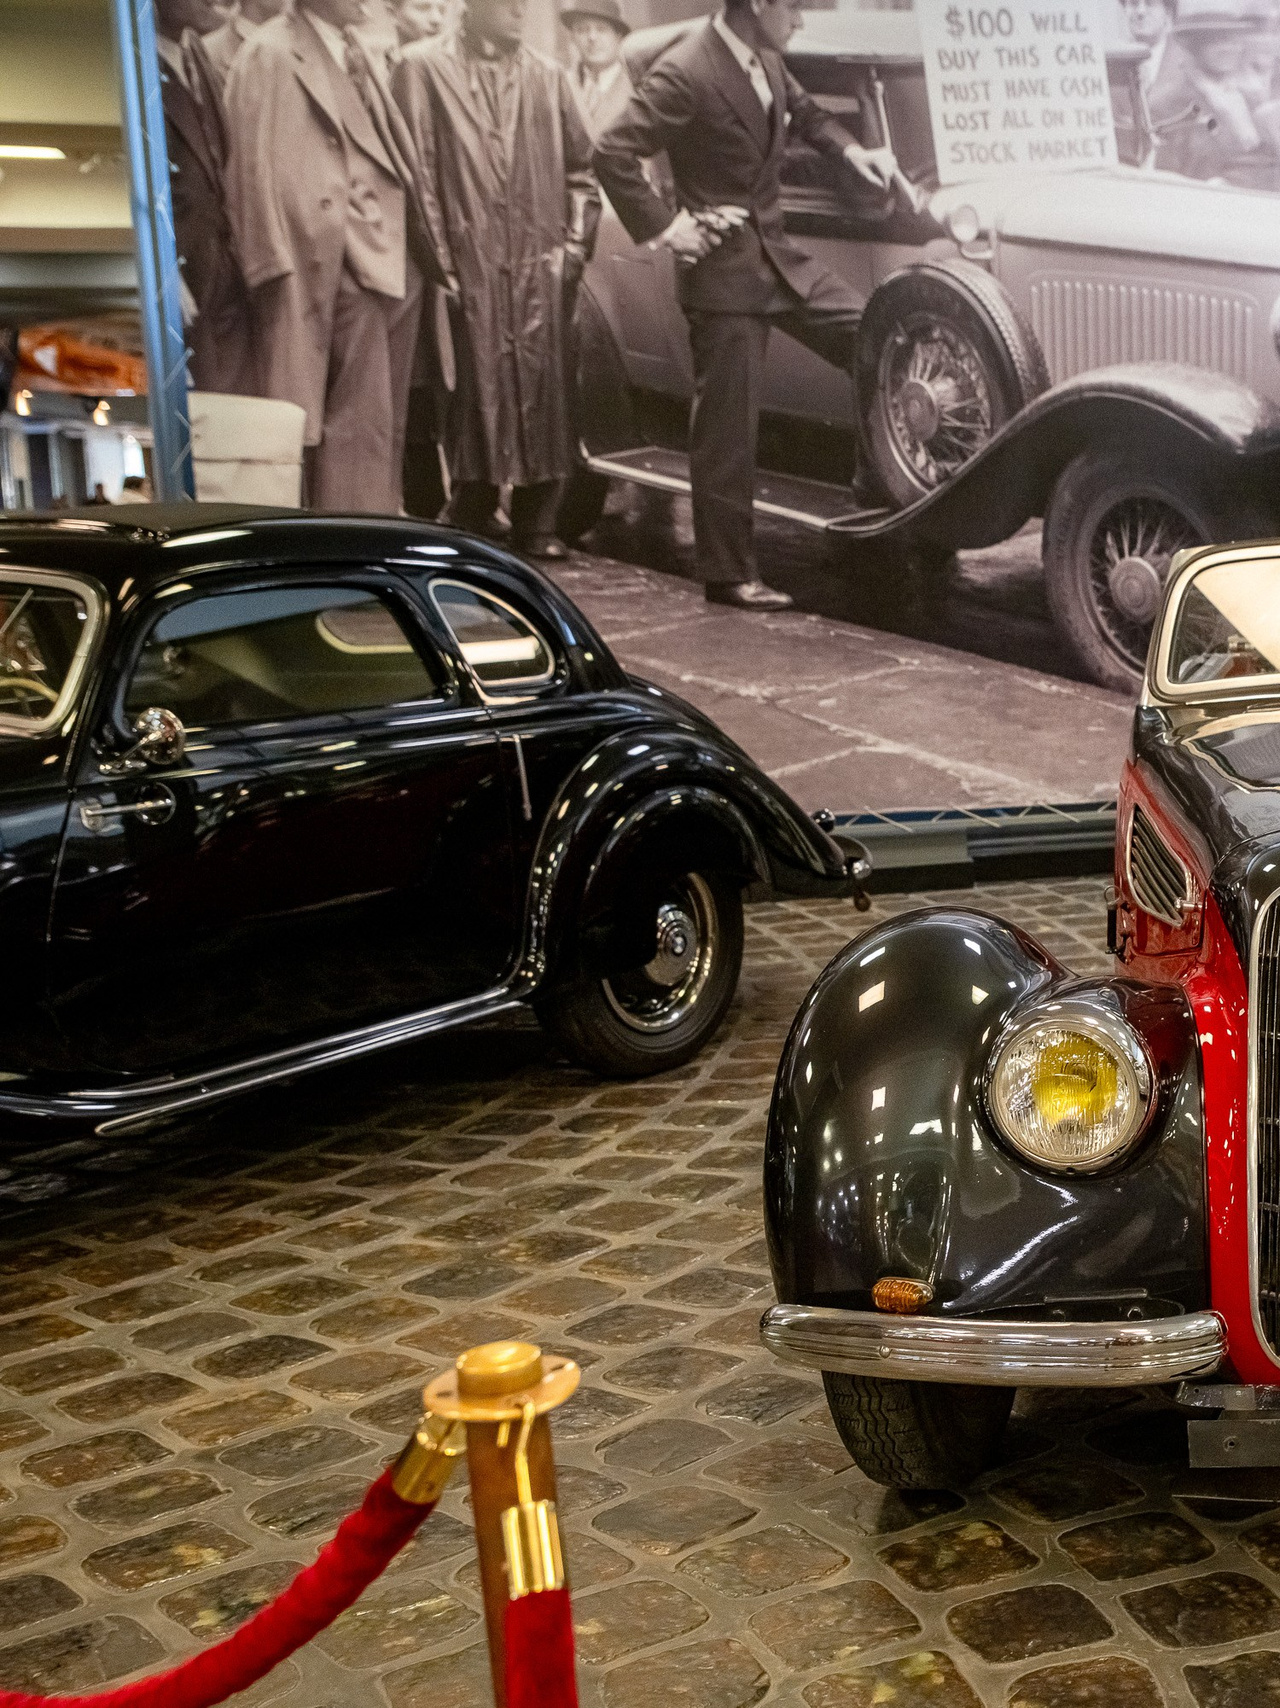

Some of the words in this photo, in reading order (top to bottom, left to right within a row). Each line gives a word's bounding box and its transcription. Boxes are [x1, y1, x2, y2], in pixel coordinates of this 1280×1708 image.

[945, 6, 1014, 40] $100
[1030, 11, 1088, 34] WILL
[936, 47, 980, 71] BUY
[994, 45, 1040, 68] THIS
[1054, 43, 1097, 65] CAR
[941, 79, 990, 102] MUST
[1004, 77, 1050, 98] HAVE
[1060, 76, 1104, 98] CASH
[942, 110, 990, 131] LOST
[1002, 108, 1034, 129] ALL
[1041, 108, 1065, 128] ON
[1074, 107, 1107, 127] THE
[949, 140, 1017, 164] STOCK
[1028, 136, 1107, 161] MARKET
